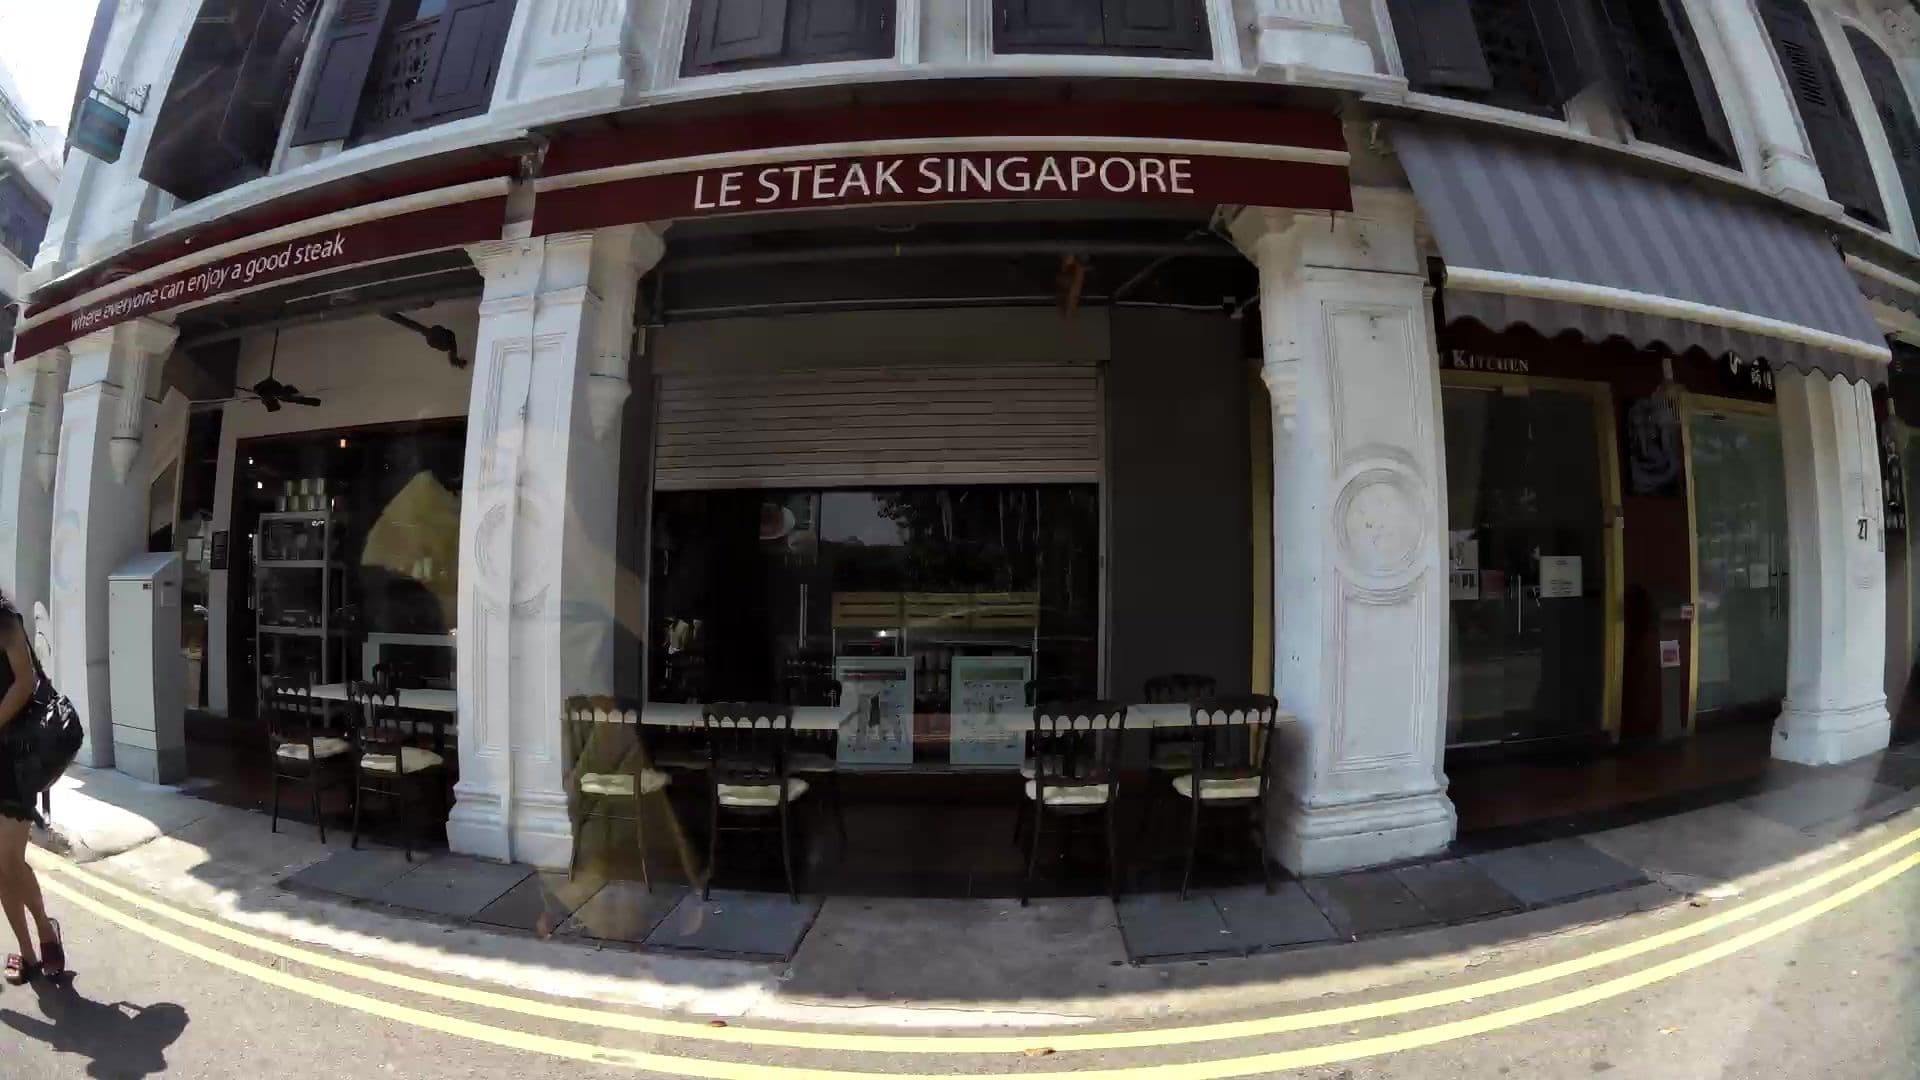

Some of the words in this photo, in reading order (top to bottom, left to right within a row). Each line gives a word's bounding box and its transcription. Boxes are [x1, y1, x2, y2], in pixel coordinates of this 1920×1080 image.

[693, 171, 744, 210] LE
[755, 159, 904, 204] STEAK
[917, 156, 1195, 194] SINGAPORE
[71, 305, 102, 332] where
[103, 288, 159, 319] everyone
[160, 280, 185, 301] can
[187, 267, 230, 293] enjoy
[231, 263, 242, 280] a
[243, 244, 293, 283] good
[293, 232, 346, 265] steak
[1857, 518, 1868, 542] 27
